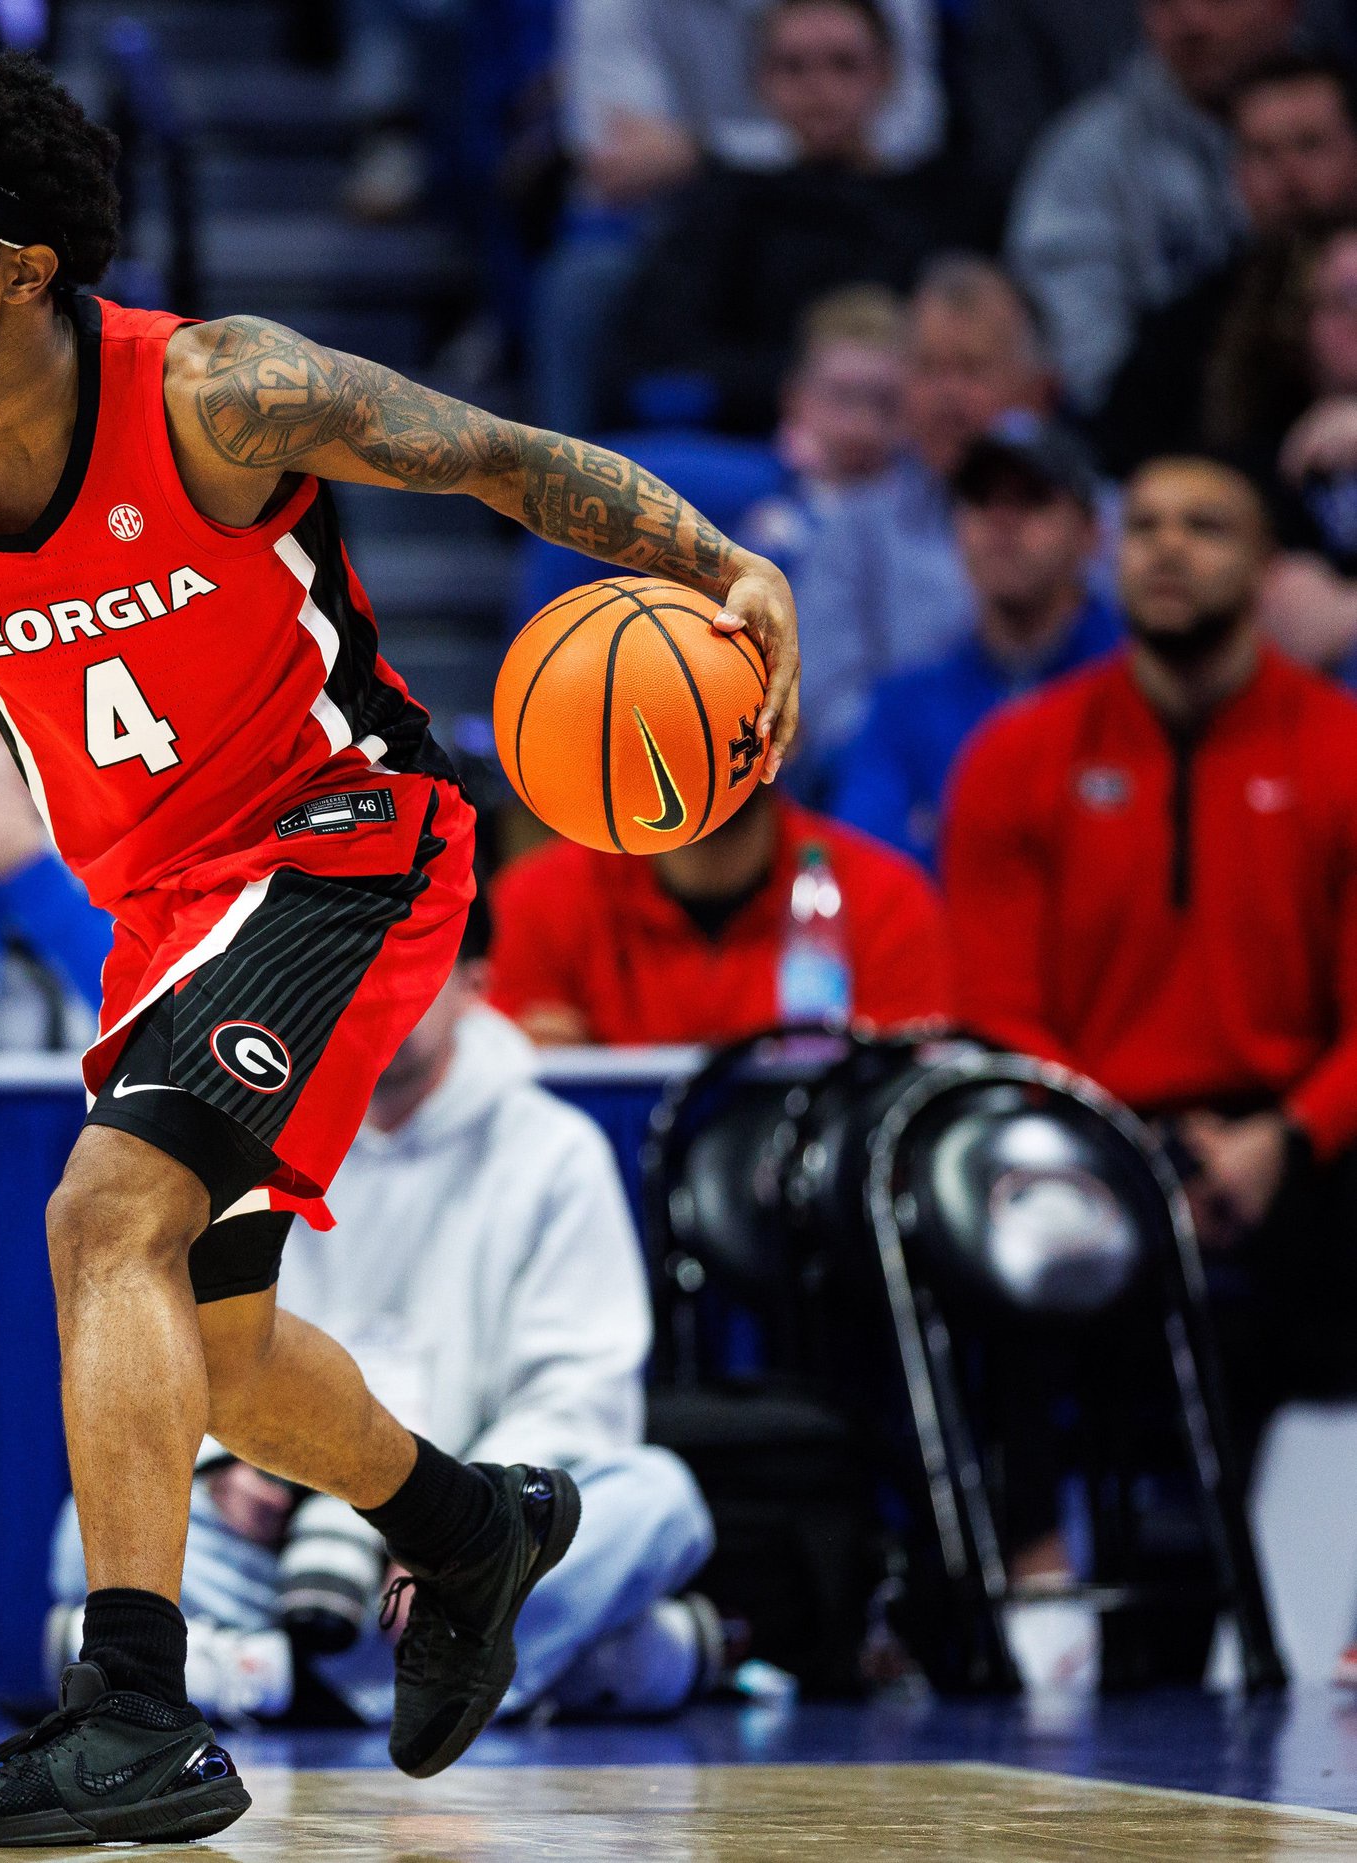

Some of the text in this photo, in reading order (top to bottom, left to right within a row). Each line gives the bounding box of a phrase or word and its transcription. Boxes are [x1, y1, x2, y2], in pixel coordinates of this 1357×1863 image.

[256, 357, 309, 417] 12
[110, 507, 141, 539] SEC
[568, 491, 610, 550] 45
[83, 653, 183, 777] 4
[357, 799, 377, 812] 46
